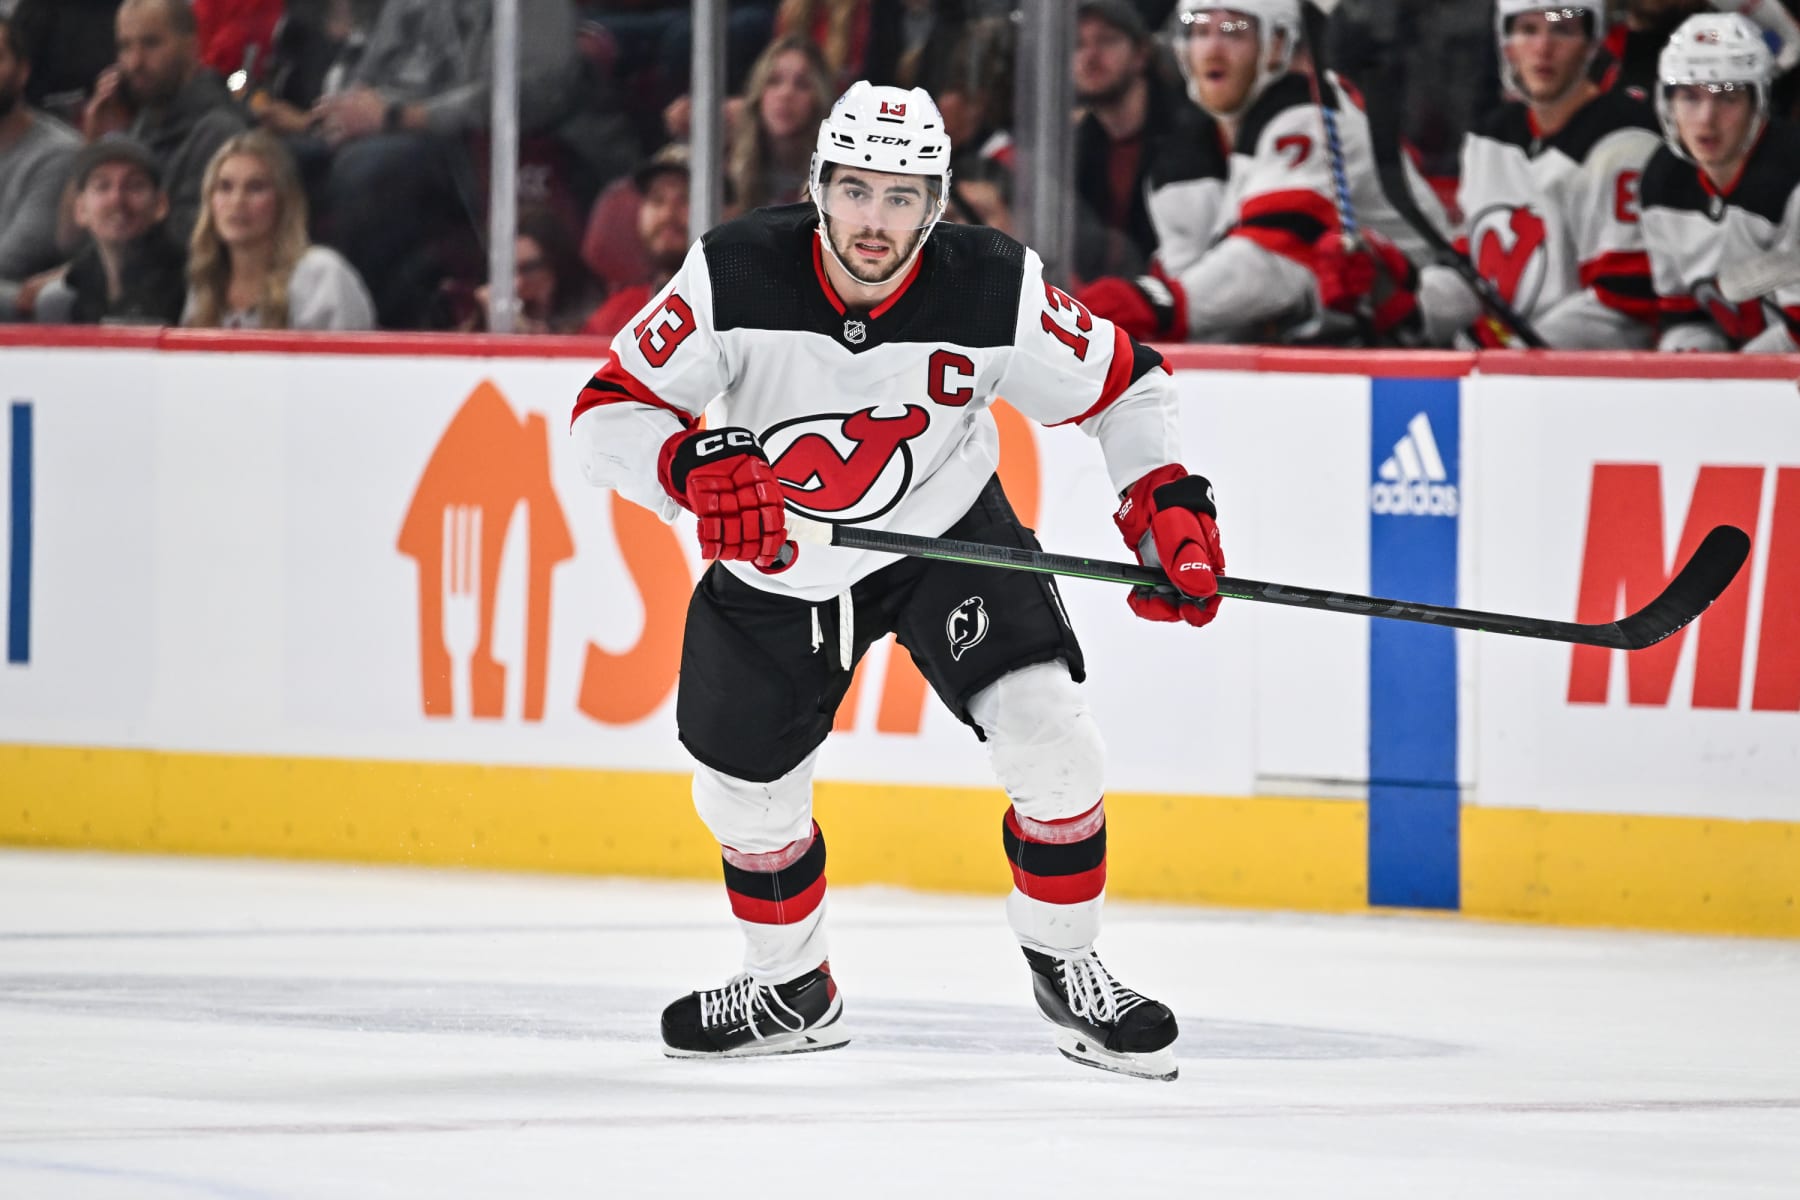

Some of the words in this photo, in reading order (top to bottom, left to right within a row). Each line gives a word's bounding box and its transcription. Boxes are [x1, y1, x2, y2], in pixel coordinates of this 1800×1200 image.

[866, 134, 912, 147] CCM
[1040, 281, 1093, 363] 13
[927, 348, 975, 407] C
[695, 431, 761, 457] CC
[1370, 481, 1460, 518] adidas
